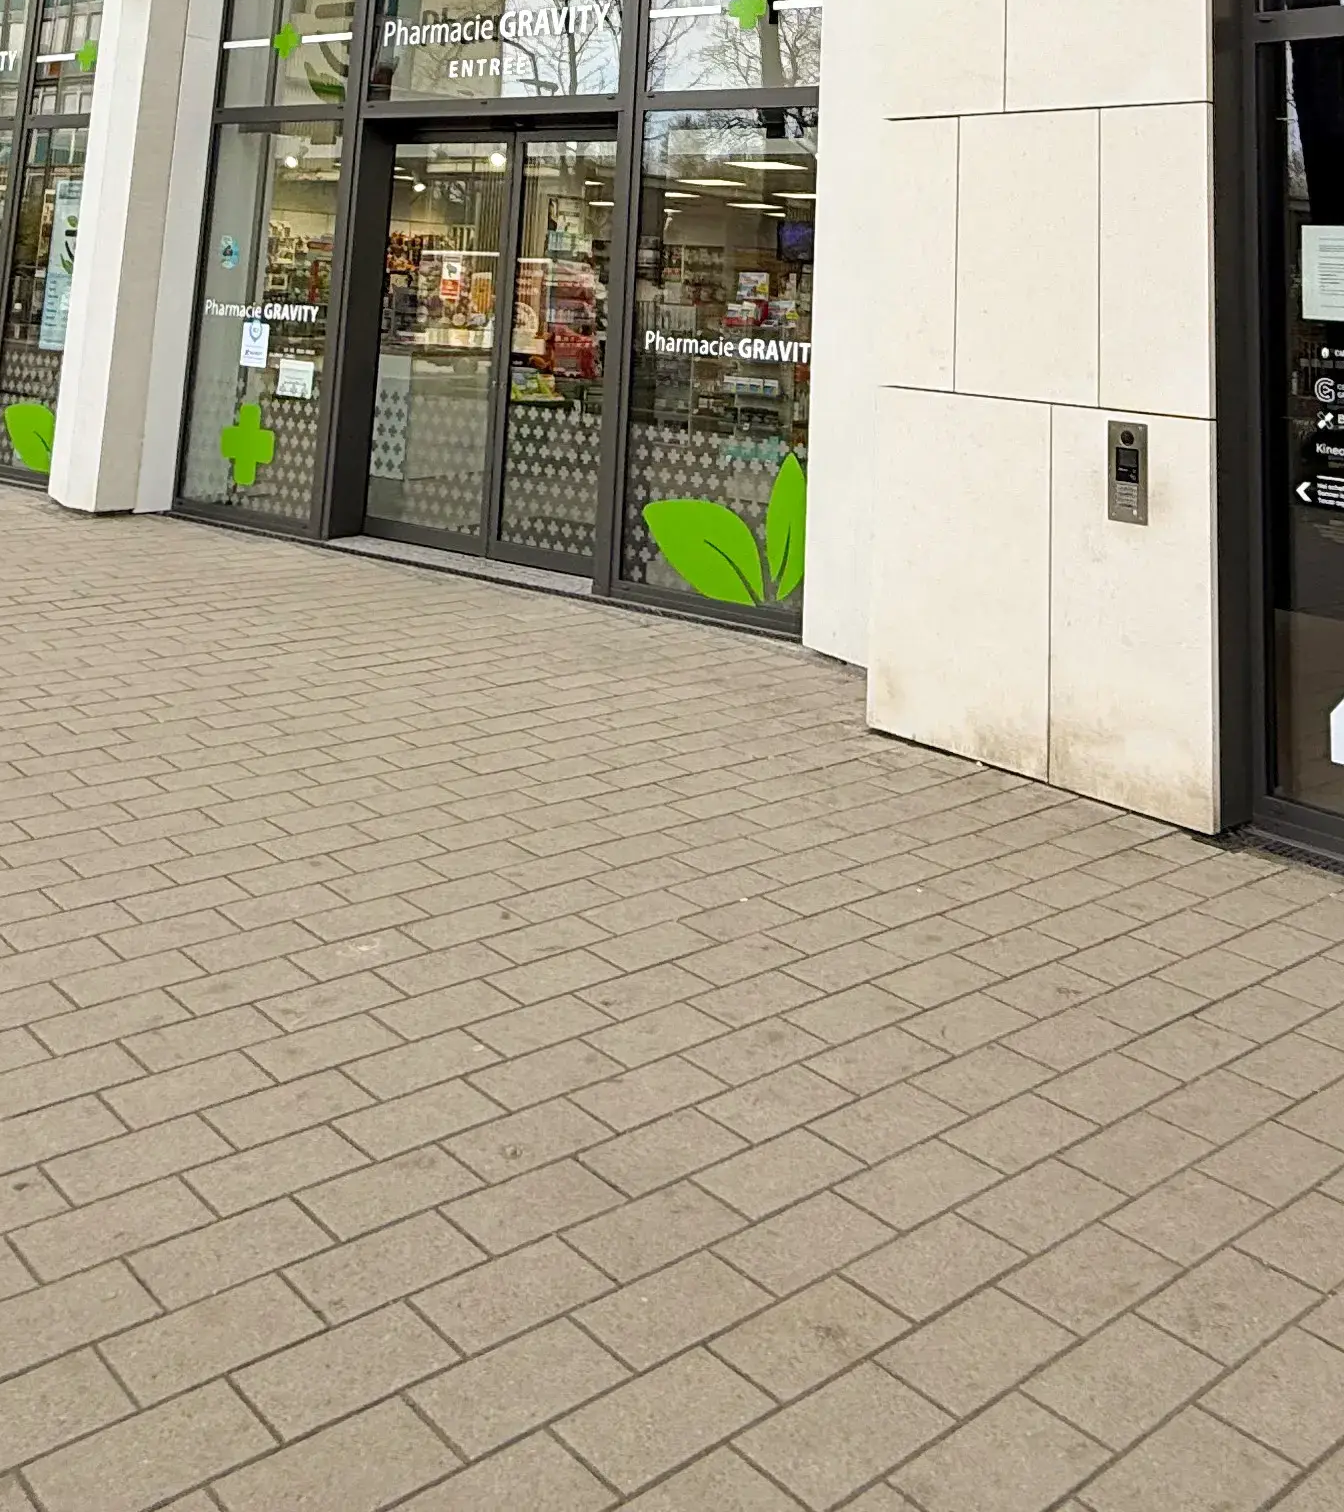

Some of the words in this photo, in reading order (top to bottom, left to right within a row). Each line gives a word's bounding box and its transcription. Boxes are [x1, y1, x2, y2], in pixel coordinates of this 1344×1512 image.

[382, 13, 494, 48] Pharmacie
[498, 1, 612, 39] GRAVITY
[447, 56, 528, 79] ENTREE
[204, 299, 262, 319] Pharmacie
[263, 302, 320, 323] GRAVITY
[644, 330, 735, 359] Pharmacie
